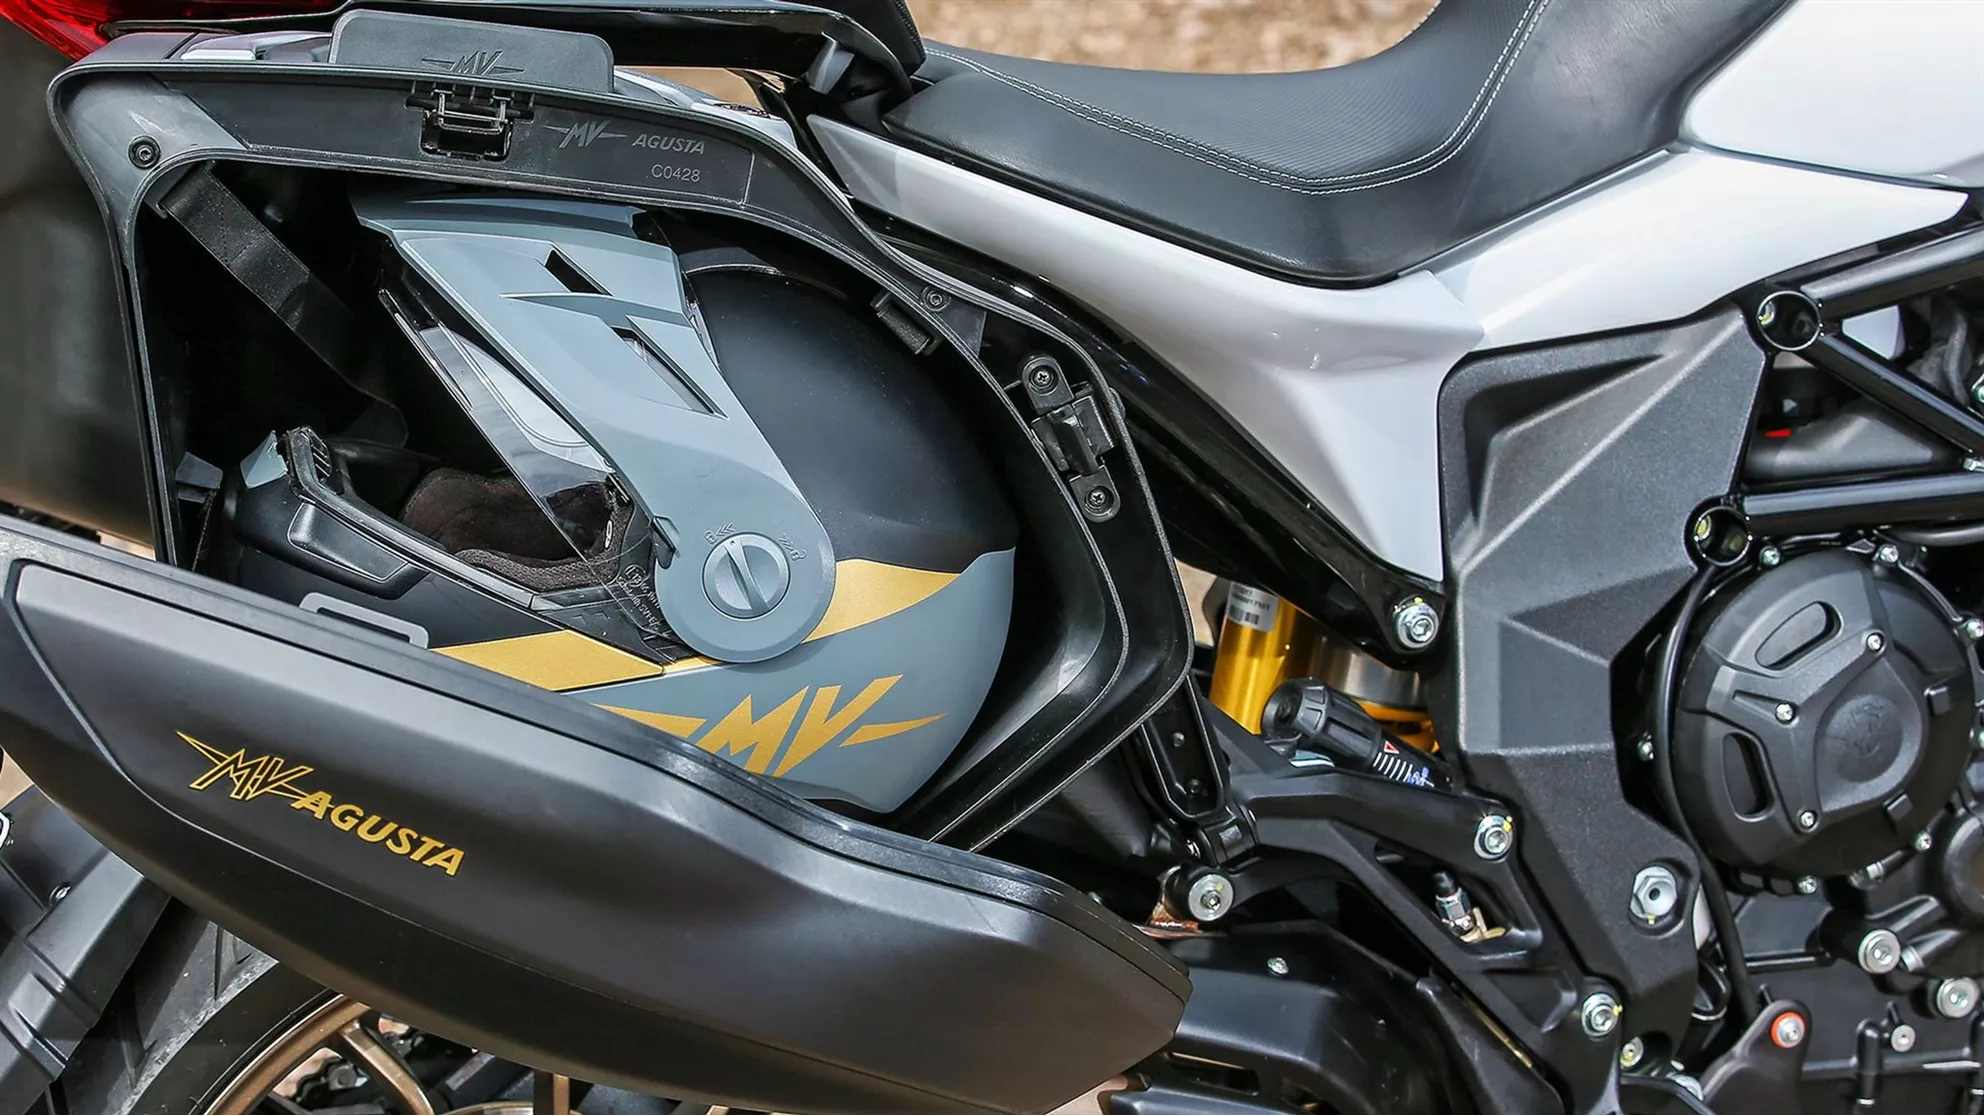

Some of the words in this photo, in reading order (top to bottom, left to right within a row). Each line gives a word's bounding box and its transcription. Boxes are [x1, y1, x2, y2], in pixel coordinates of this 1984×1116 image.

[631, 133, 705, 155] AGUSTA
[651, 163, 701, 183] C0428
[695, 673, 904, 780] MV
[188, 748, 315, 801] MV
[290, 790, 466, 877] AGUSTA
